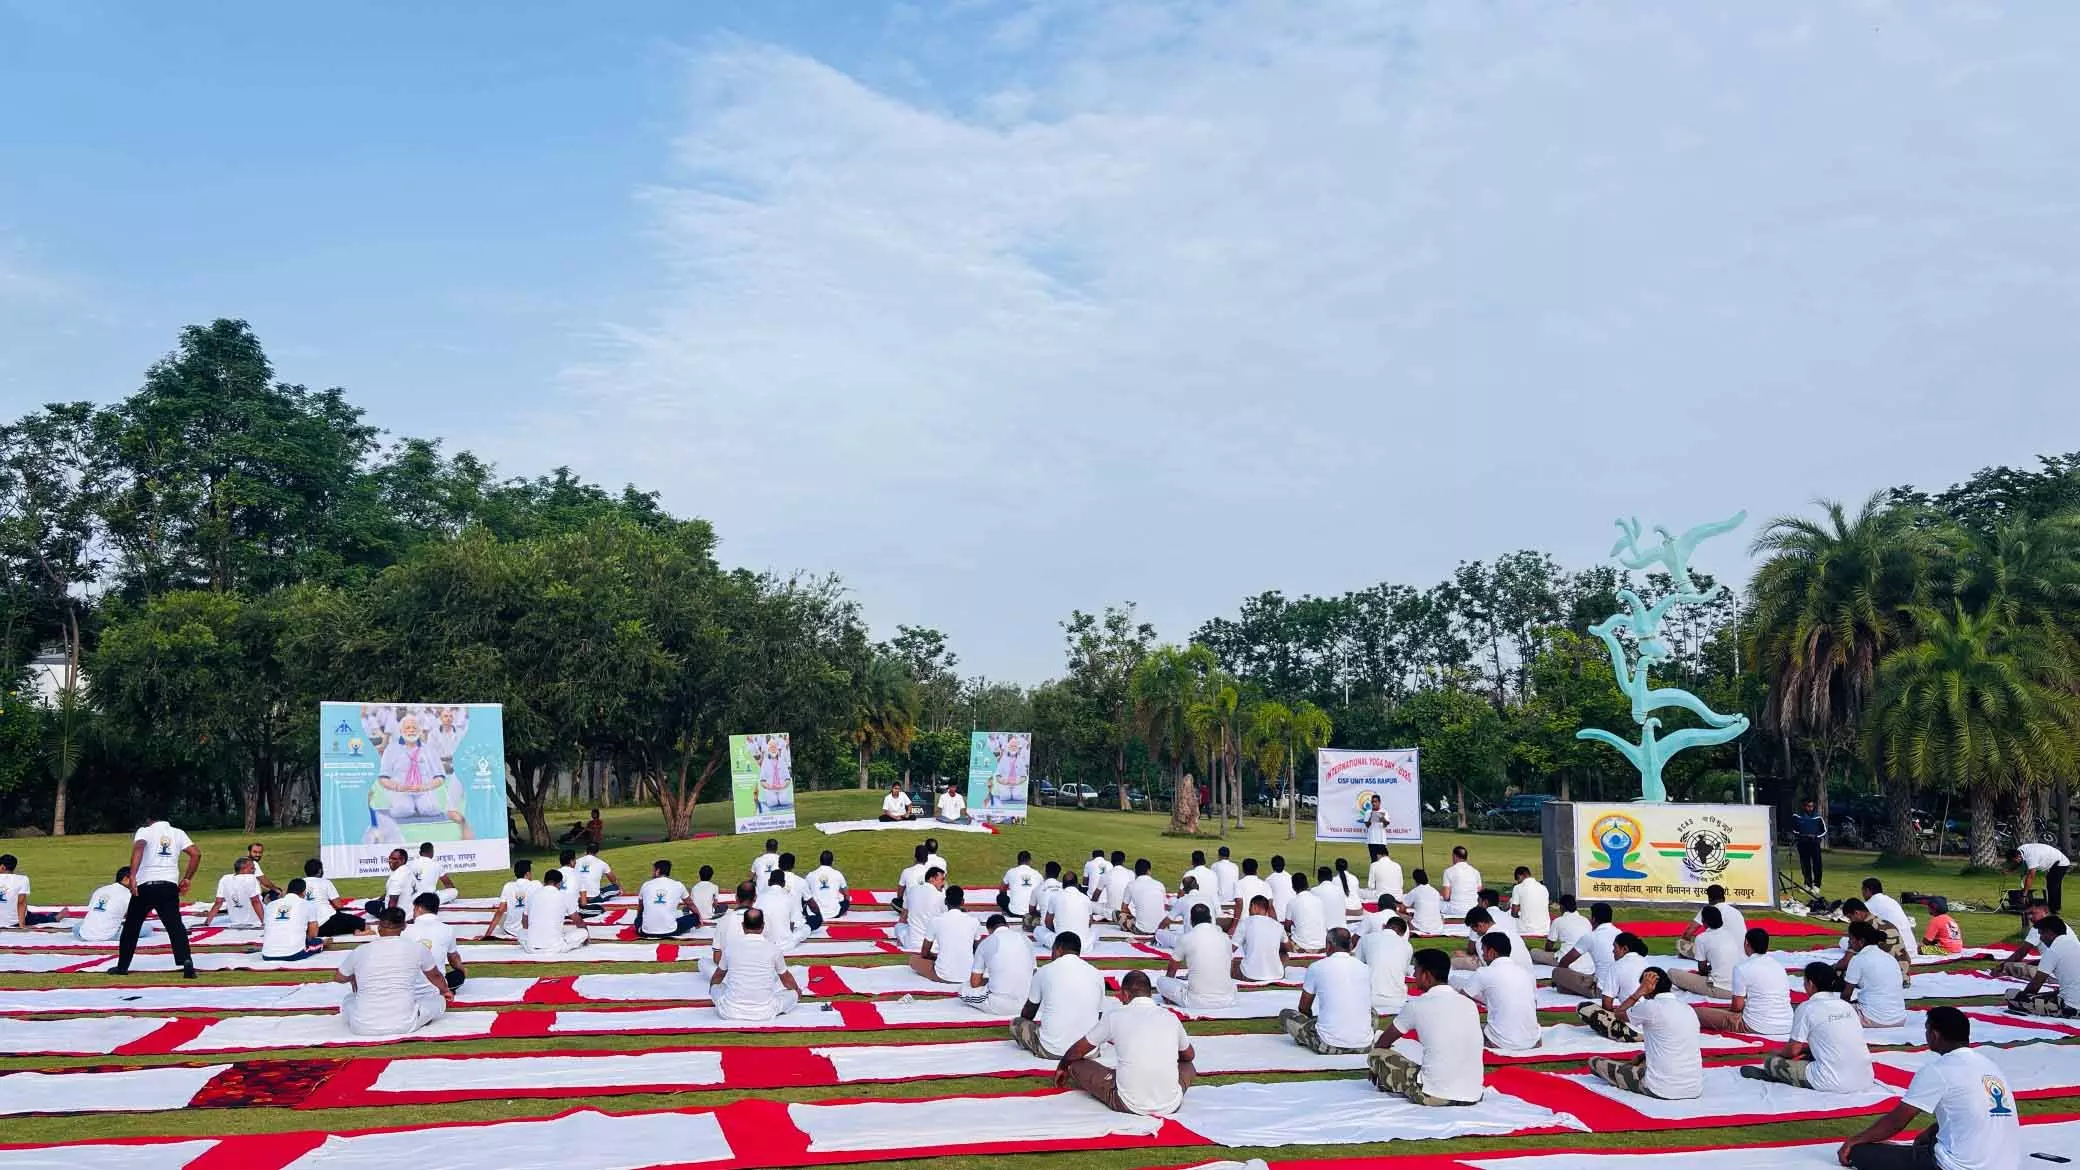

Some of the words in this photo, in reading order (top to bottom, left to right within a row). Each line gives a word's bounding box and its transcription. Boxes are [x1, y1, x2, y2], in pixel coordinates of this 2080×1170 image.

[1326, 756, 1367, 782] INTERNATIONAL
[1369, 757, 1384, 768] YOGA
[1337, 777, 1349, 785] CISF
[1350, 777, 1364, 785] UNIT
[1365, 777, 1376, 785] ASG
[1377, 777, 1398, 785] RAIPUR
[1677, 818, 1694, 832] BCAS
[359, 866, 380, 874] SWAMI
[454, 862, 477, 870] RAIPUR
[1645, 885, 1663, 894] नागर
[1666, 884, 1691, 895] विमानन
[1733, 887, 1755, 899] रायपुर
